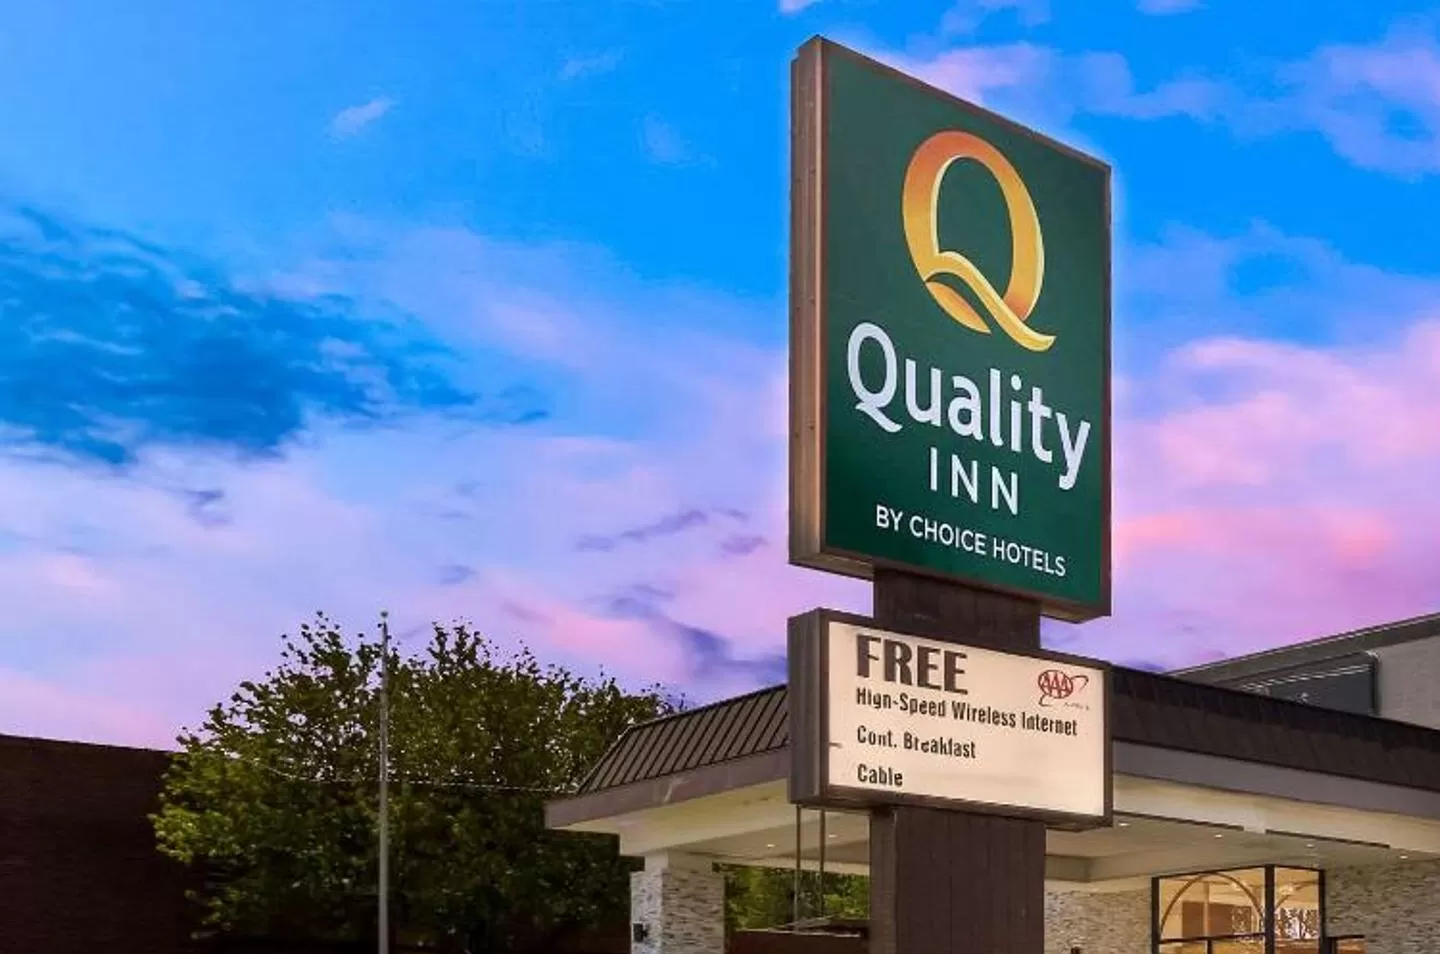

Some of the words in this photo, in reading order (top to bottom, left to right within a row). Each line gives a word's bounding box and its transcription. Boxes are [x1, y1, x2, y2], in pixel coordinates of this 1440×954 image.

[903, 130, 1056, 352] Q
[847, 321, 1091, 491] Quality
[929, 447, 1020, 516] INN
[876, 505, 904, 530] BY
[909, 515, 987, 557] CHOICE
[992, 538, 1067, 578] HOTELS
[856, 634, 969, 696] FREE
[1039, 670, 1073, 699] AAA
[857, 725, 898, 748] Cont.
[903, 731, 976, 759] Breakfast
[951, 700, 1016, 729] Wireless
[1021, 711, 1078, 736] Internet
[857, 763, 903, 787] Cable
